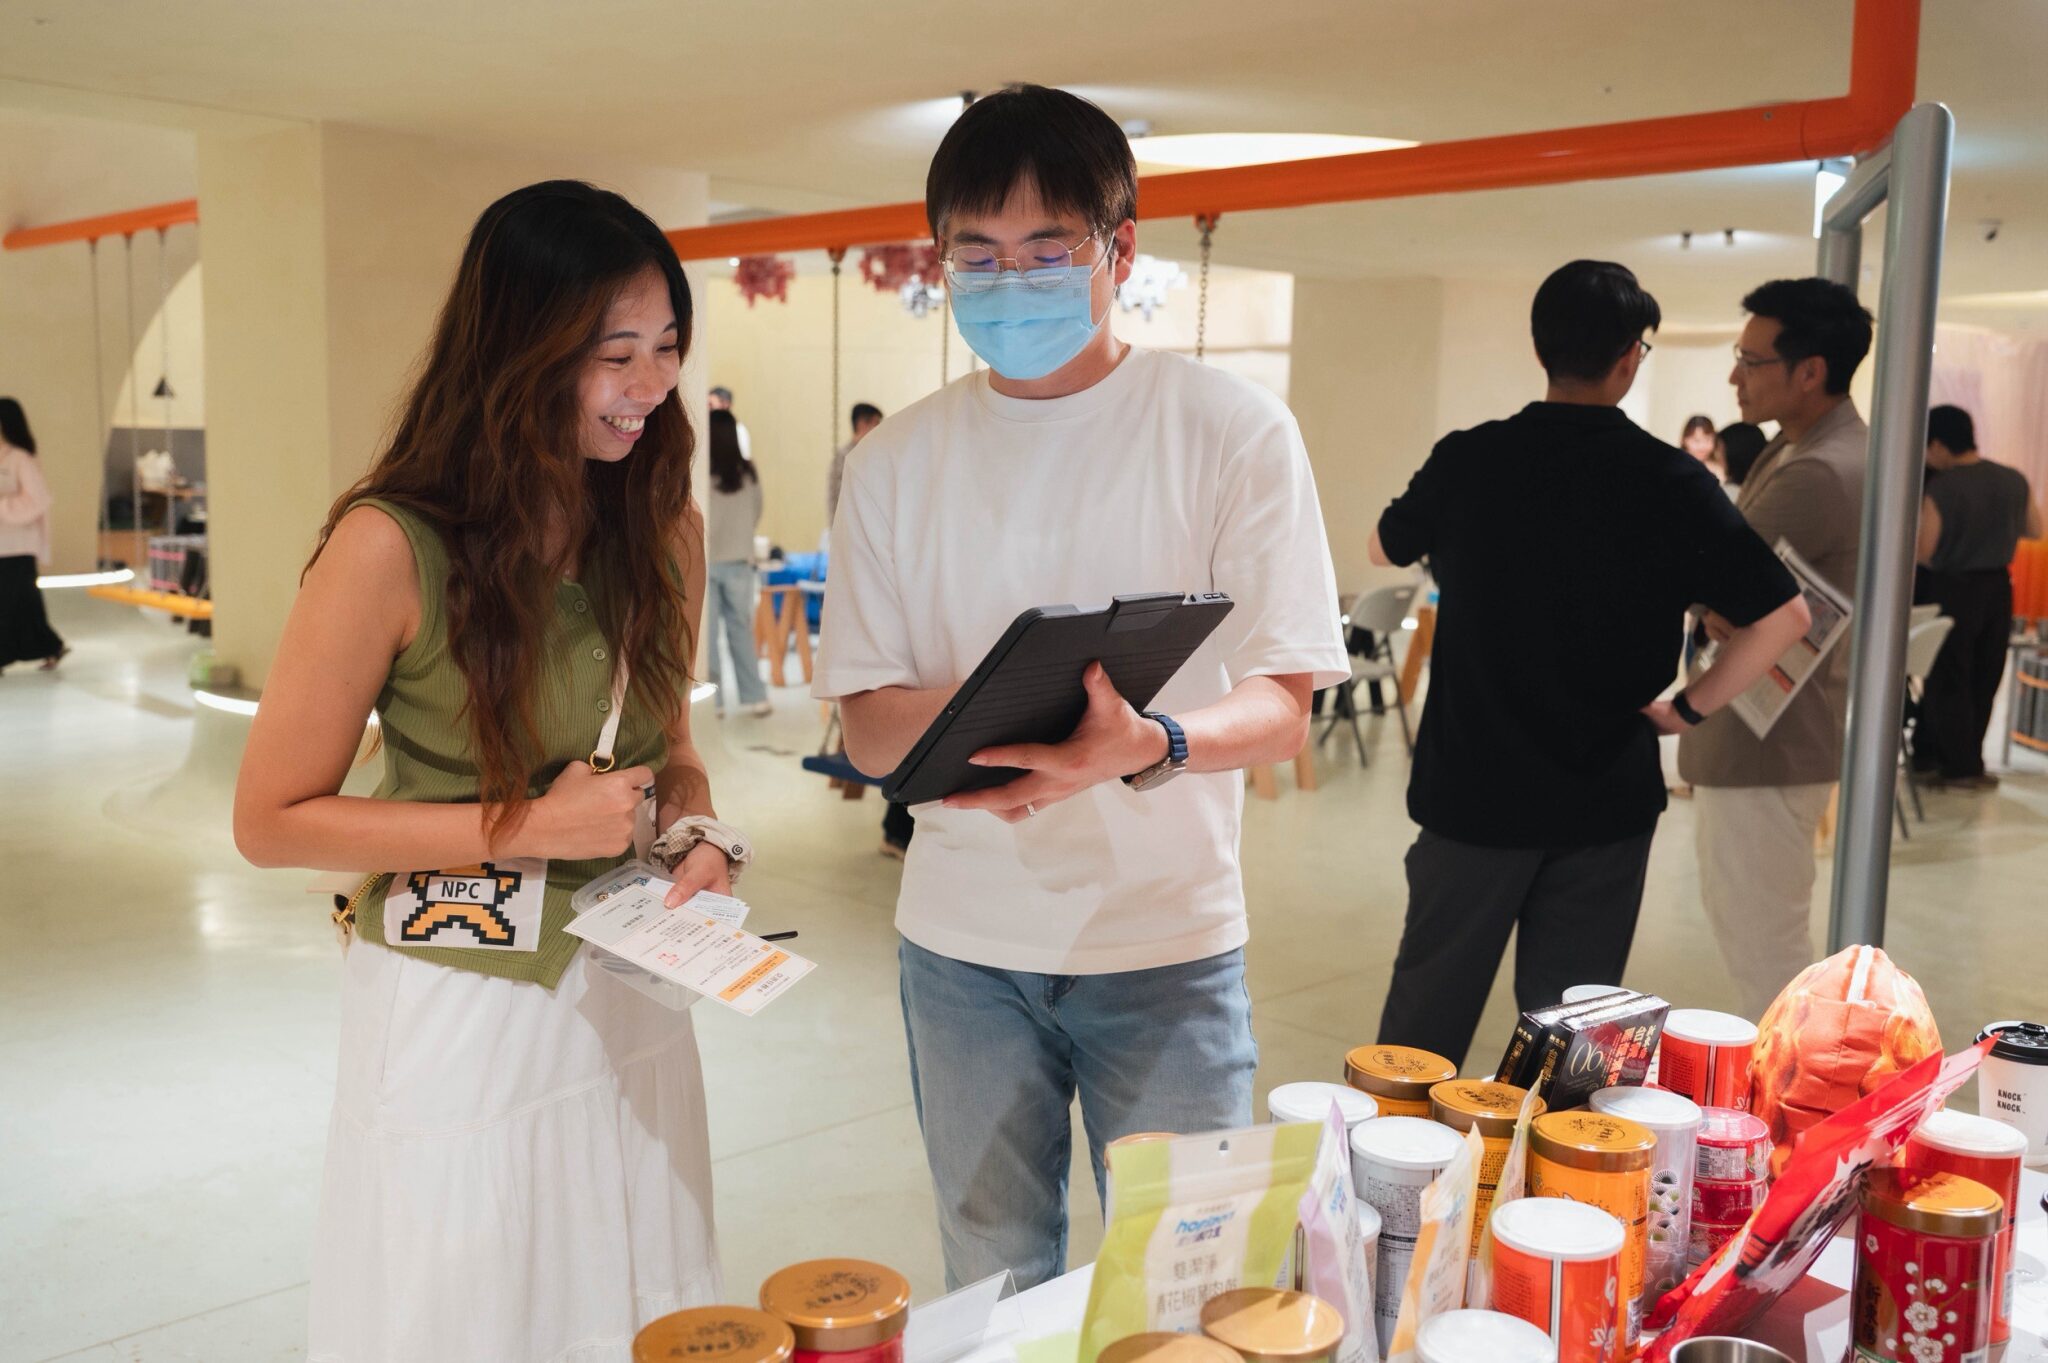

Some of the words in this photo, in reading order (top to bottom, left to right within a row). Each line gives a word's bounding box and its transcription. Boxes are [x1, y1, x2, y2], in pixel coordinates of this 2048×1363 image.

[441, 881, 480, 899] NPC
[1570, 1035, 1608, 1077] 06
[1998, 1089, 2022, 1102] KNOCK
[1997, 1100, 2021, 1113] KNOCK
